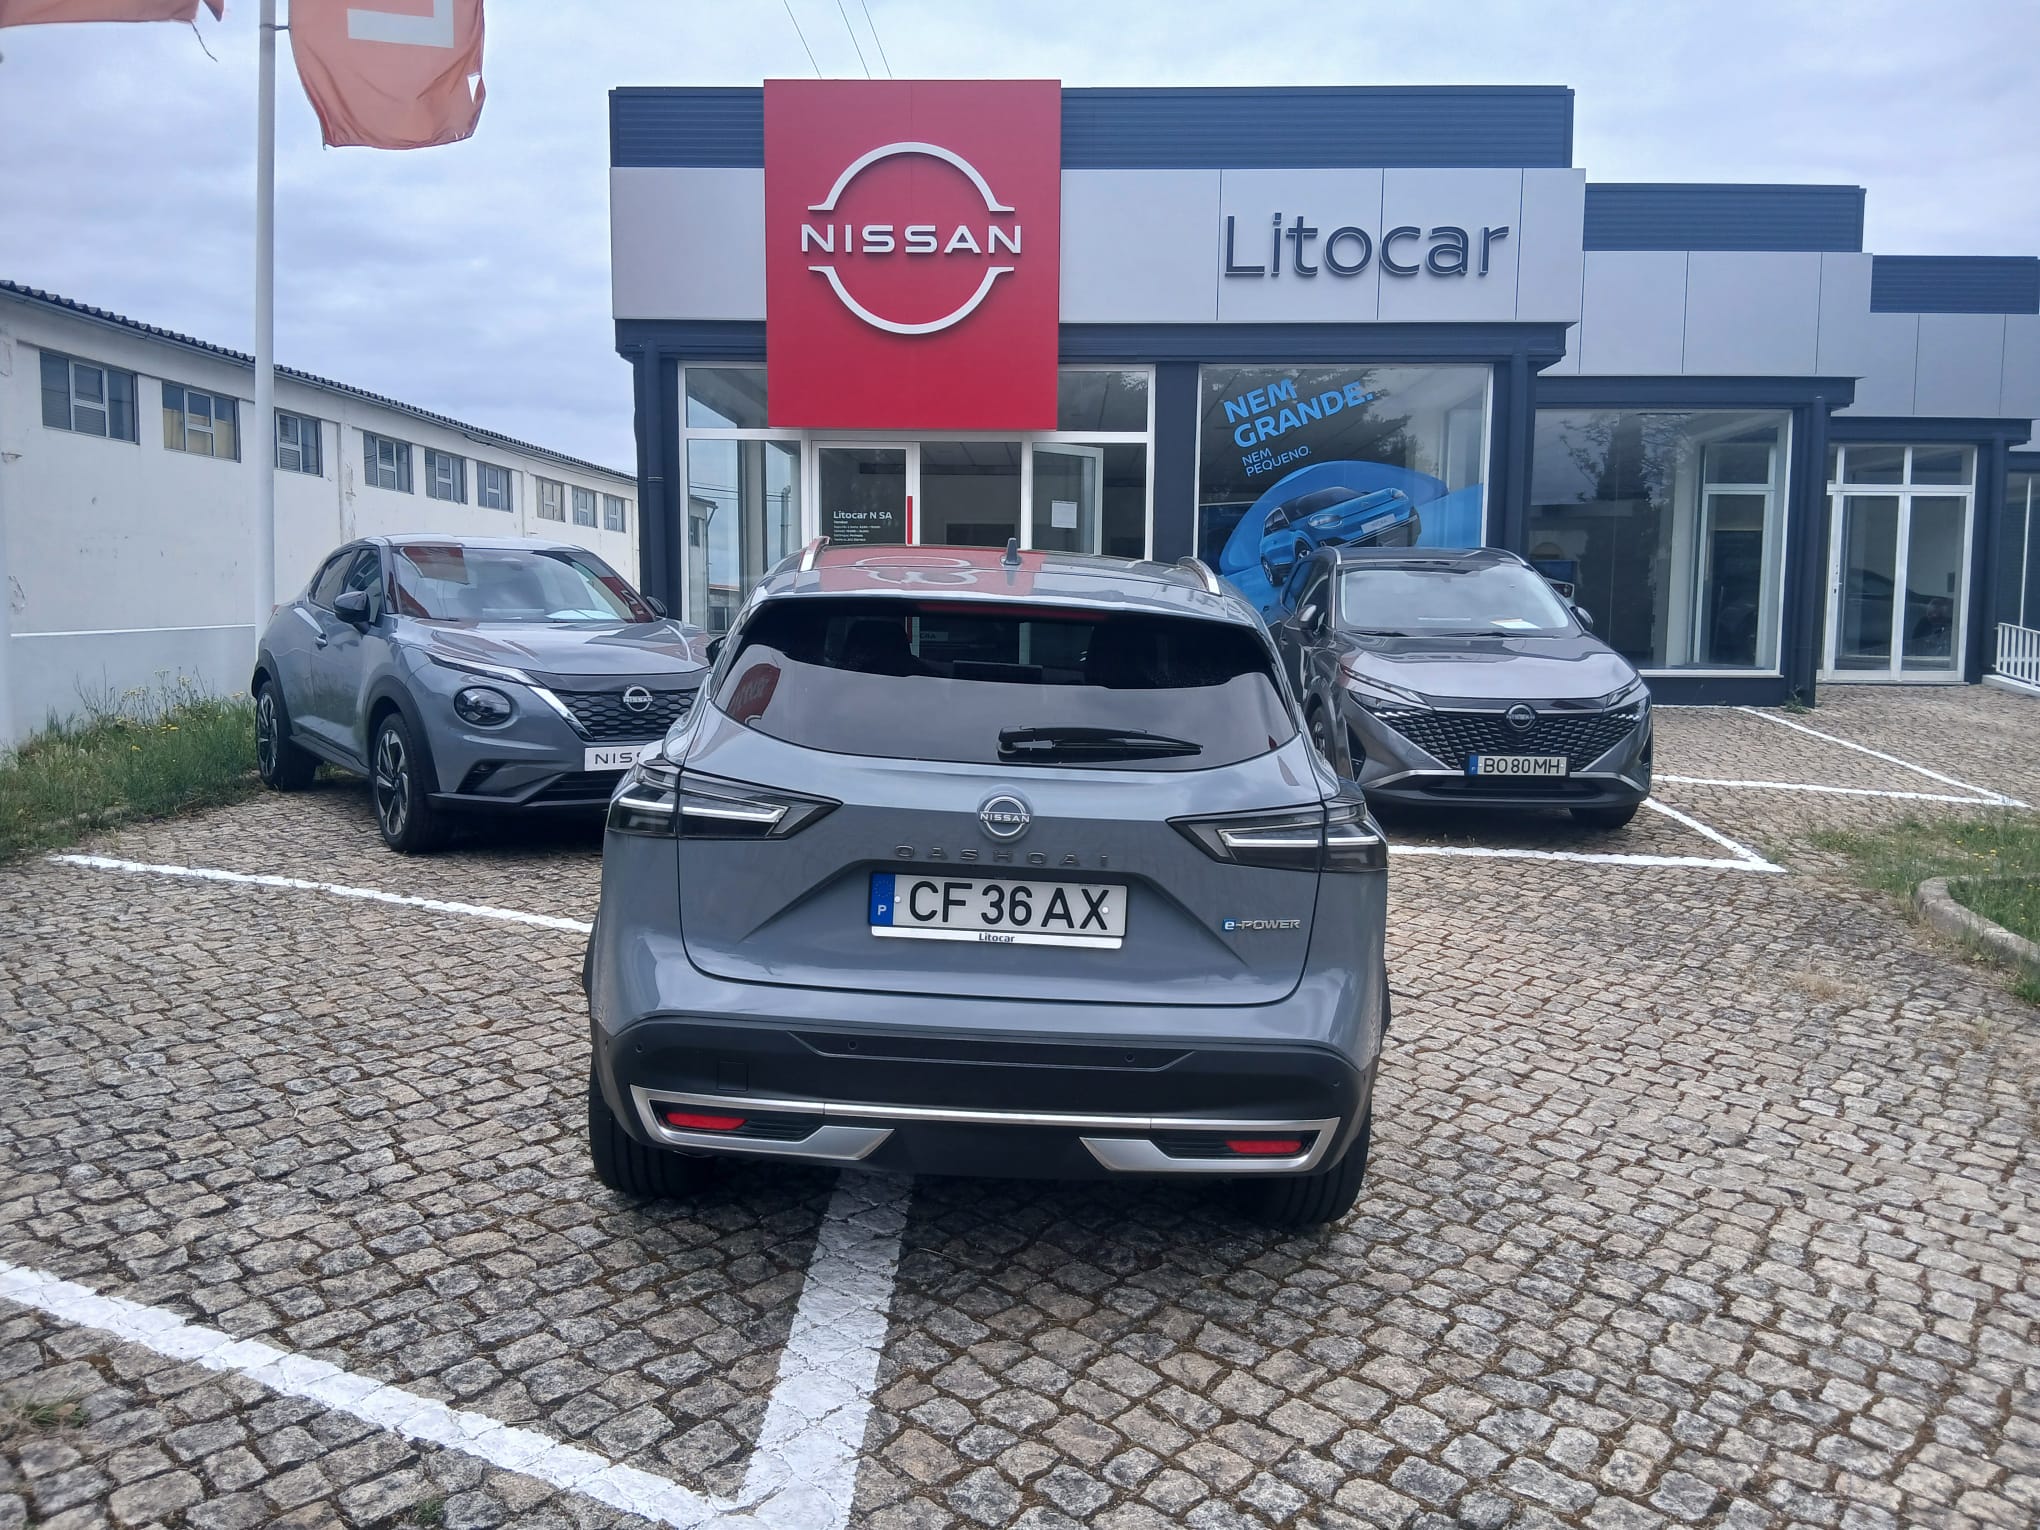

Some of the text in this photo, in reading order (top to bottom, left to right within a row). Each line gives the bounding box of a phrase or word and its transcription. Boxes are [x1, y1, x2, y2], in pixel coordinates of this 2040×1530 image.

[800, 224, 1021, 254] NISSAN
[1223, 212, 1509, 277] Litocar
[1223, 378, 1297, 423] NEM
[1234, 381, 1373, 448] GRANDE.
[1241, 447, 1272, 466] NEM
[1246, 445, 1312, 477] PEQUENO.
[833, 511, 892, 520] Litocar N SA
[594, 752, 640, 764] NIS
[1484, 758, 1560, 774] BO 80 MH
[979, 812, 1031, 824] NISSAN
[877, 880, 1110, 931] P CF 36 AX
[1224, 919, 1301, 930] e-POWER
[979, 933, 1015, 944] Litocar
